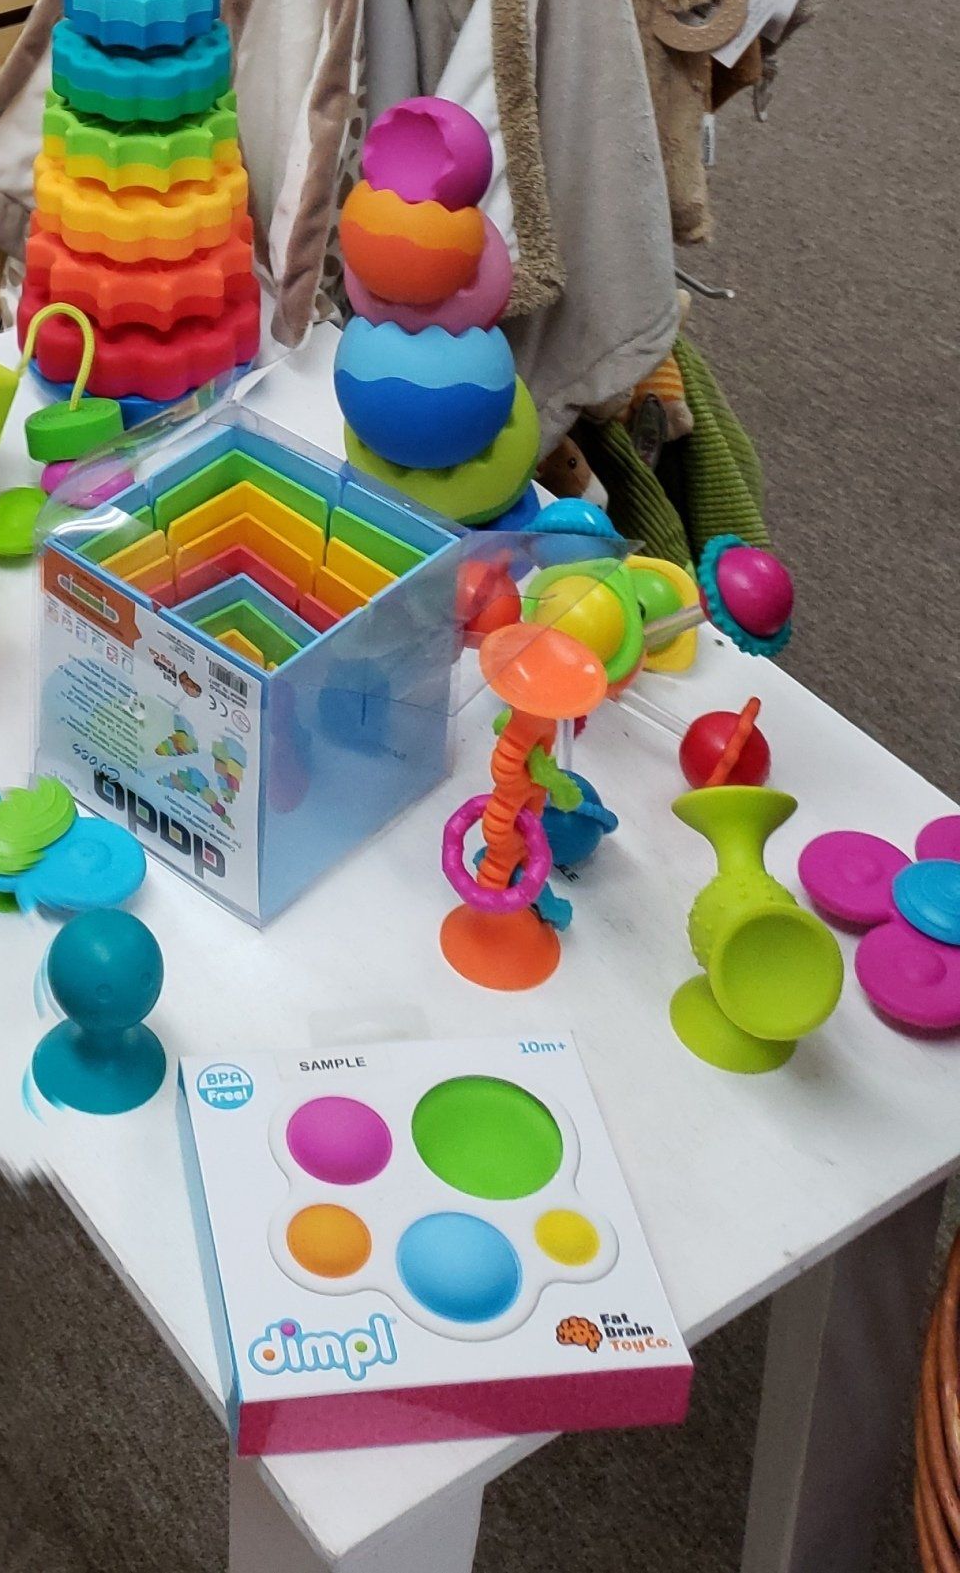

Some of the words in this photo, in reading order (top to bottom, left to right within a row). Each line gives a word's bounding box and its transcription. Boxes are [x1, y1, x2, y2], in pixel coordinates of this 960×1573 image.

[94, 769, 226, 879] dado
[518, 1040, 567, 1054] 10m+
[299, 1056, 367, 1072] SAMPLE
[206, 1072, 243, 1086] BPA
[207, 1088, 248, 1103] Free!
[600, 1313, 629, 1326] Fat
[604, 1324, 654, 1339] Brain
[249, 1313, 398, 1380] dimpl
